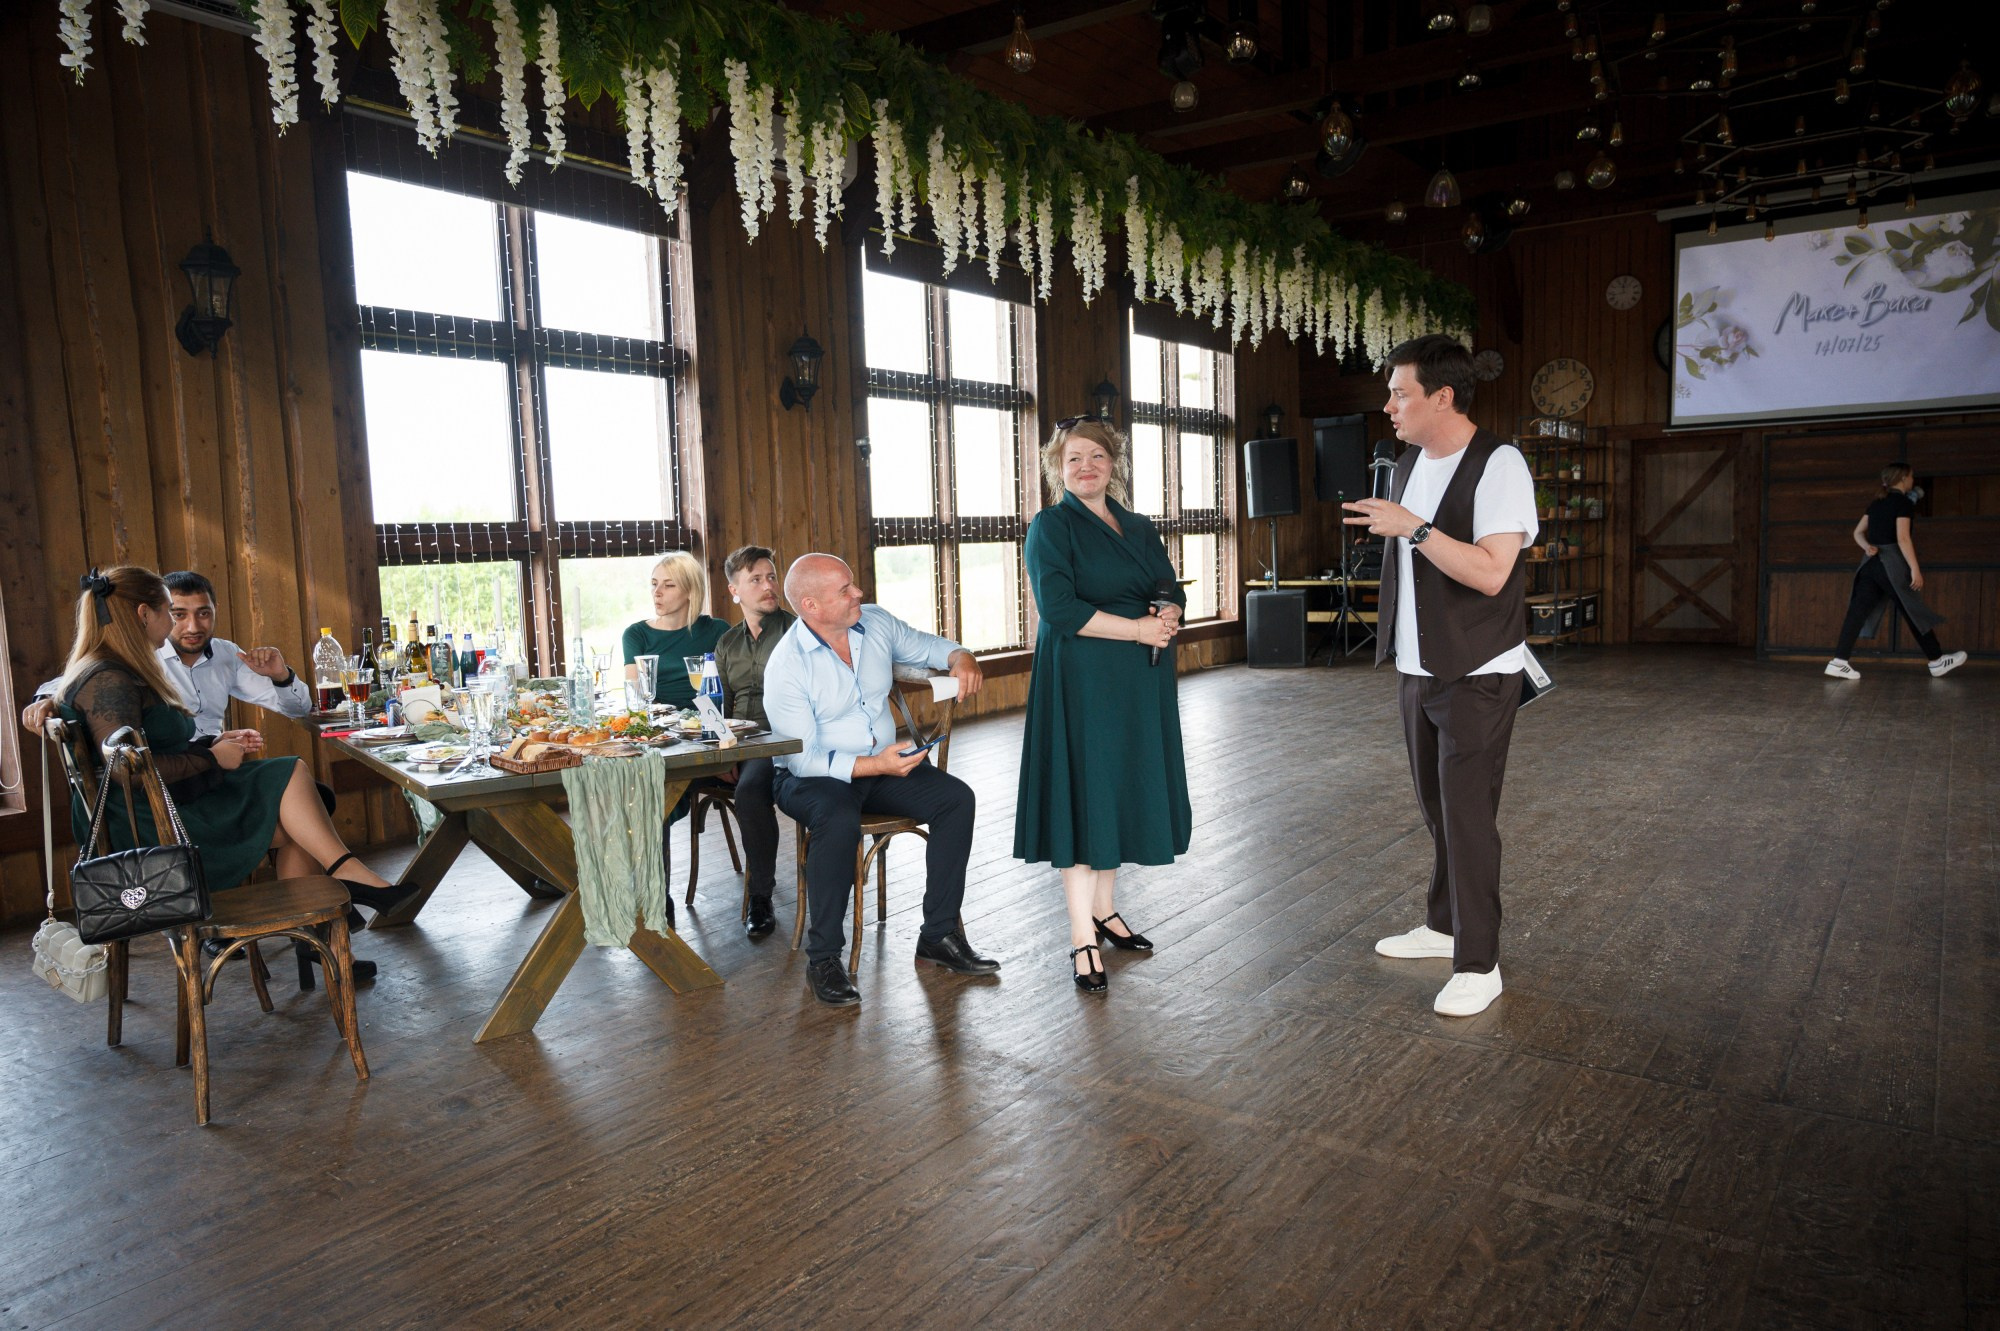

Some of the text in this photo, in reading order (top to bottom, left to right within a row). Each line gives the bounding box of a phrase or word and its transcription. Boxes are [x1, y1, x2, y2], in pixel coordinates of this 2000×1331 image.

[1815, 333, 1885, 356] 14/07/25
[1557, 360, 1568, 370] 12
[1580, 368, 1588, 379] 2
[1584, 380, 1592, 391] 3
[1547, 403, 1555, 413] 7
[1558, 404, 1566, 416] 6
[1571, 401, 1579, 411] 5
[707, 708, 727, 735] 3
